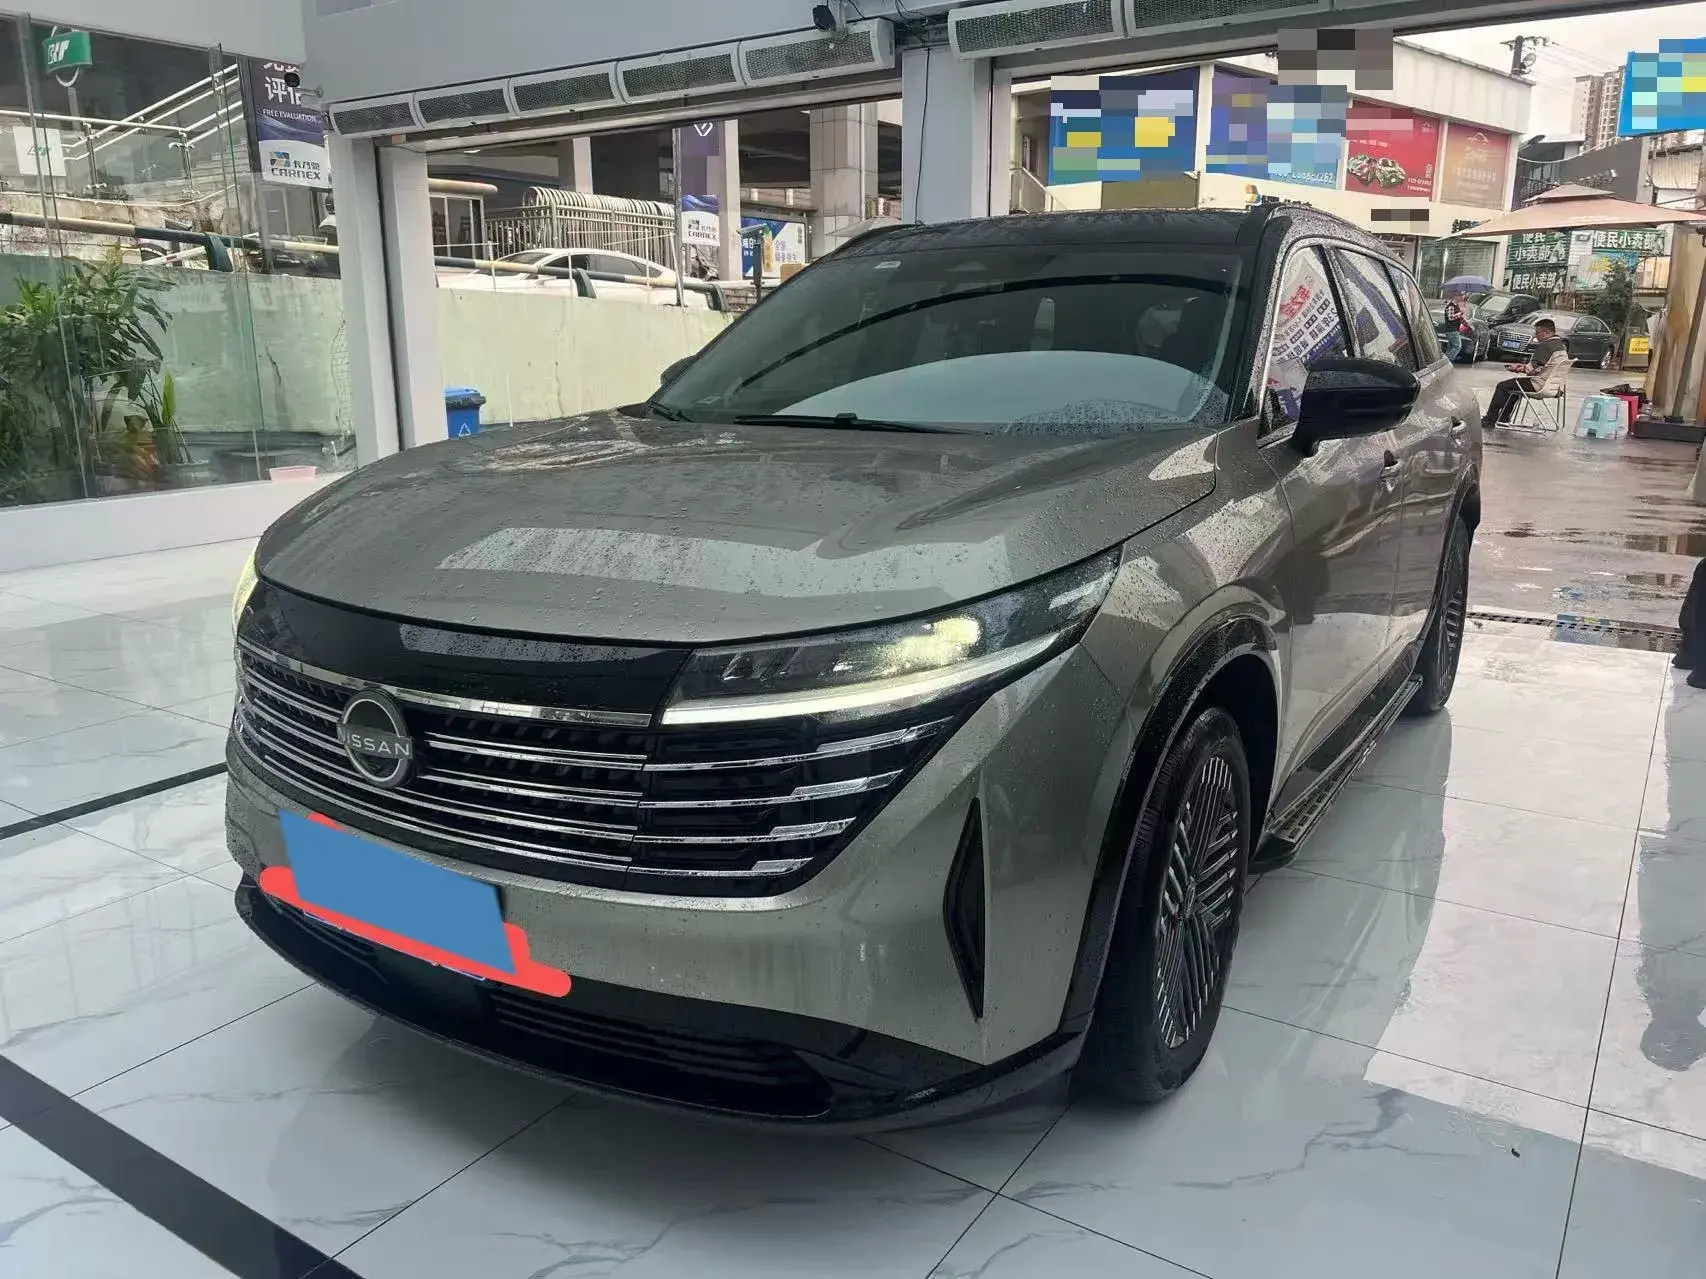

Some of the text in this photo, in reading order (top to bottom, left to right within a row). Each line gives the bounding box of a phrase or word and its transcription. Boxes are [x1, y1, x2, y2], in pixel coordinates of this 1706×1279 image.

[263, 108, 317, 123] FREE EVALUATION
[271, 168, 321, 180] CARNEX
[688, 230, 717, 240] CARNEX
[1523, 231, 1546, 244] 便民
[1594, 231, 1657, 248] 便民小卖部
[1514, 245, 1551, 262] 小卖部
[1512, 272, 1557, 290] 便民小卖部
[337, 724, 410, 756] NISSAN
